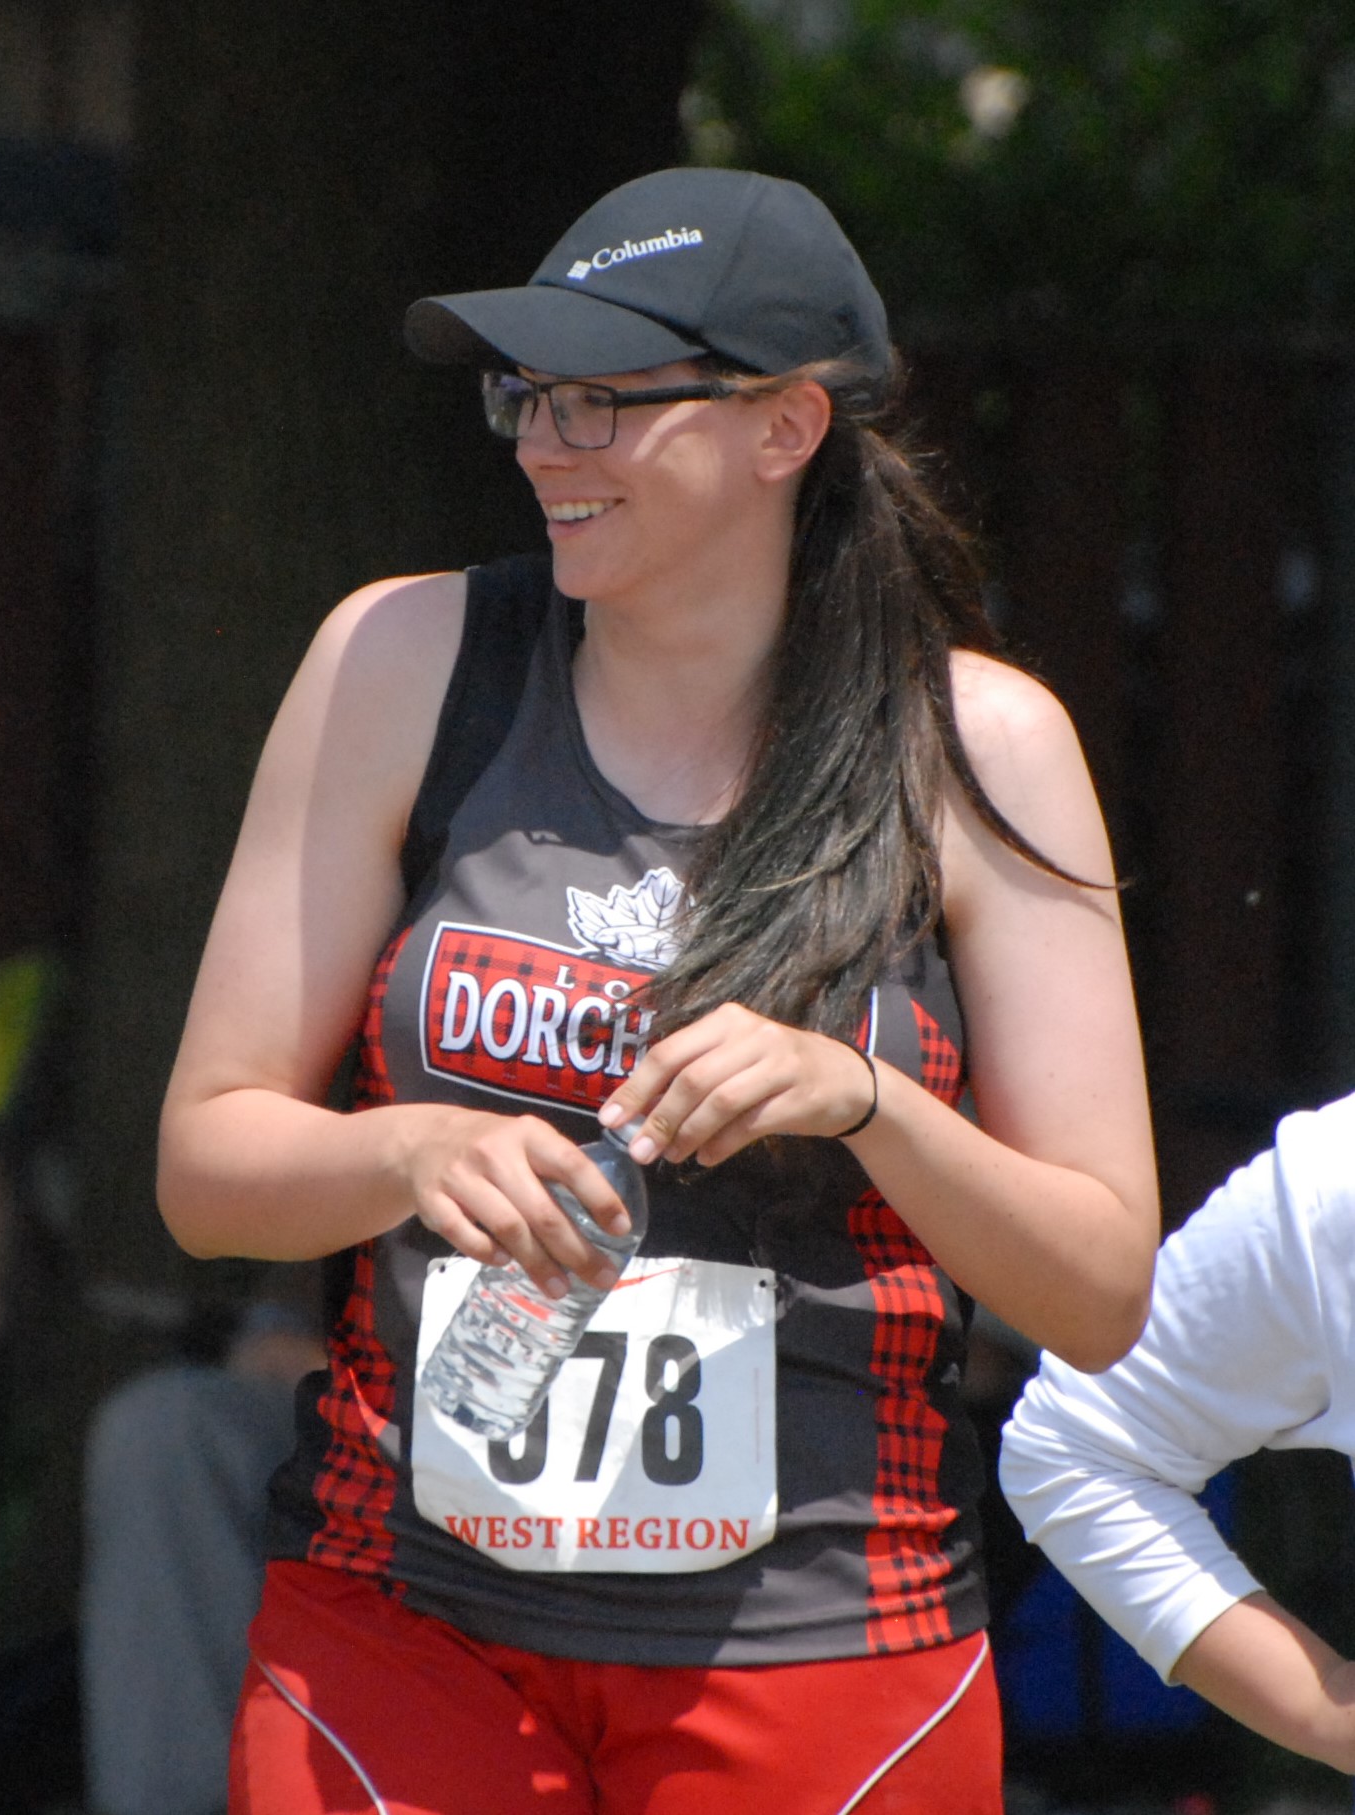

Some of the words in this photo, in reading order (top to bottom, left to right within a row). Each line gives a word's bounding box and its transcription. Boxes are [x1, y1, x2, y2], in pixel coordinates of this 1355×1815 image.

[591, 227, 704, 270] Columbia
[555, 964, 631, 1000] LO
[438, 970, 657, 1078] DORCH
[446, 1515, 563, 1550] WEST
[576, 1516, 750, 1550] REGION
